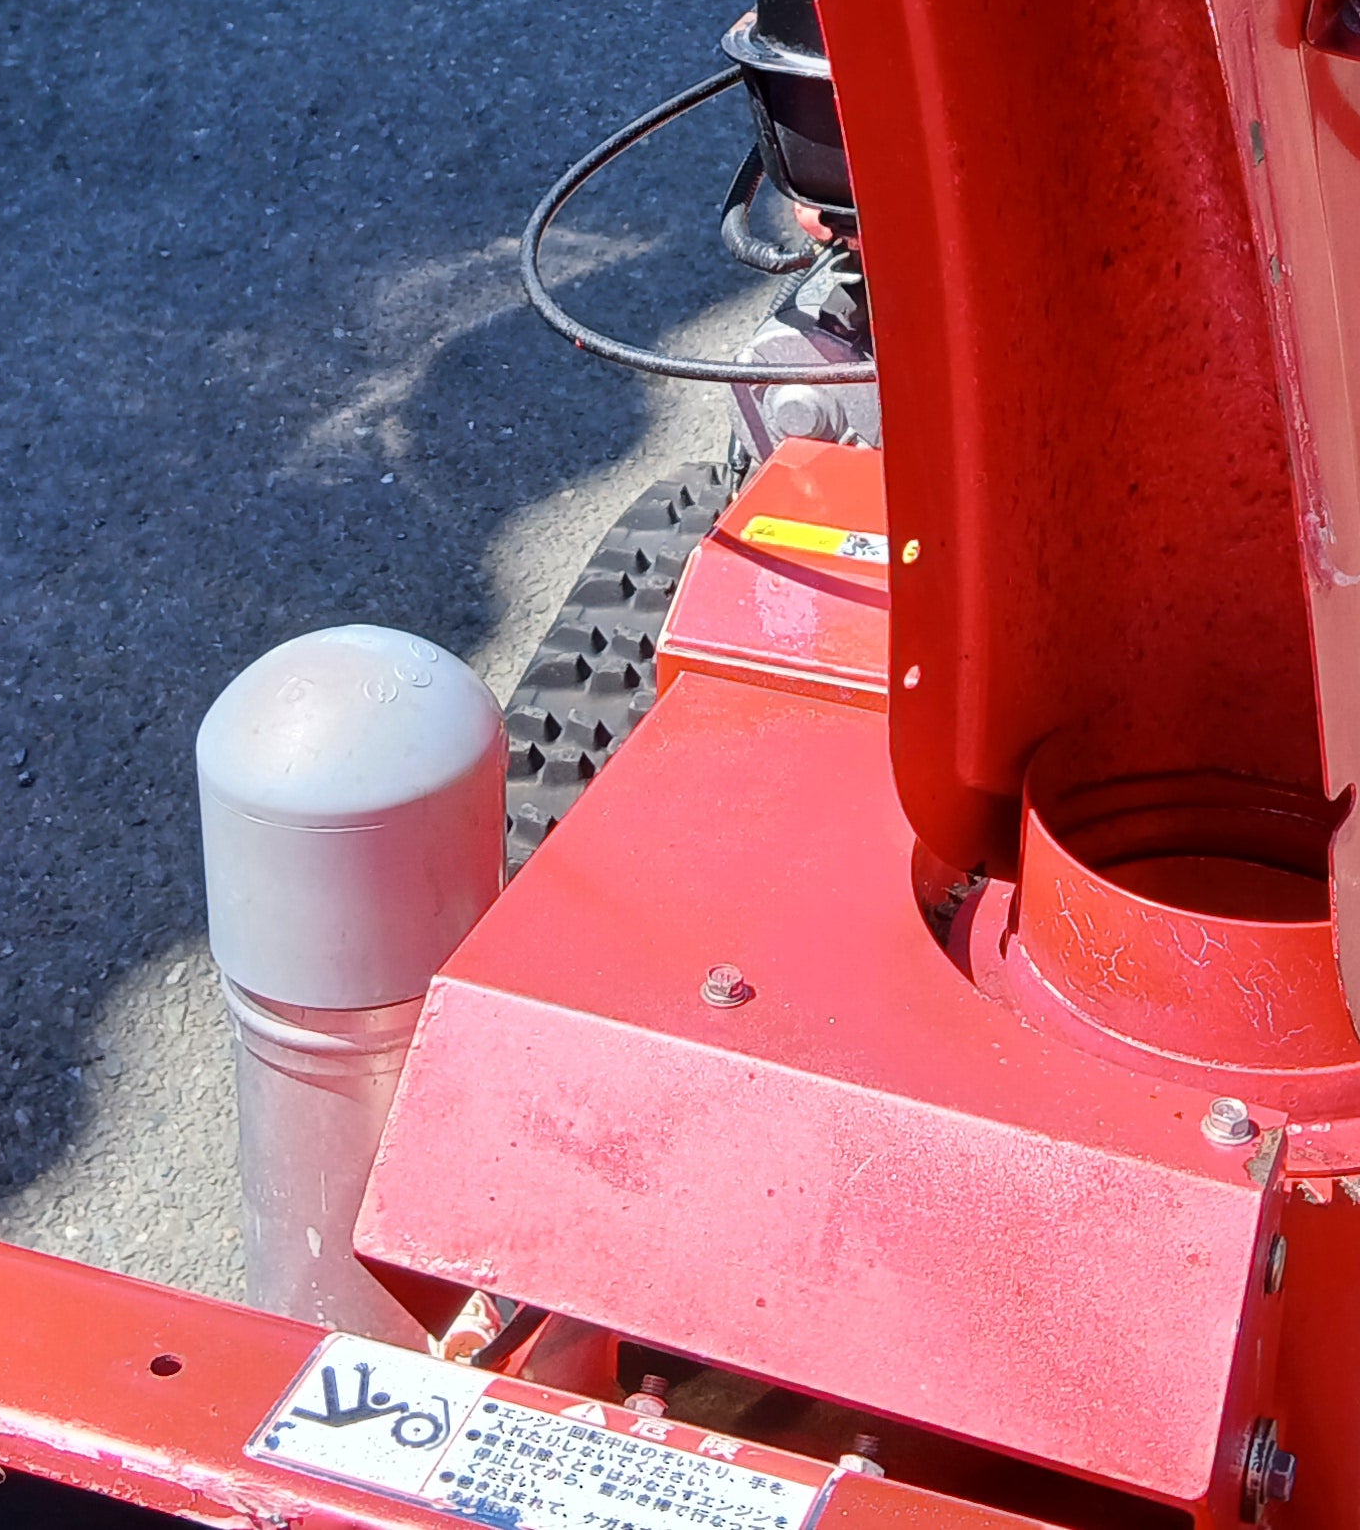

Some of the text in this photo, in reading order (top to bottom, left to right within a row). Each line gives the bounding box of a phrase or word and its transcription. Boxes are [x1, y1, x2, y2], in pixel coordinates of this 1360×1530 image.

[629, 1417, 744, 1461] 危険
[467, 1462, 541, 1494] ください。
